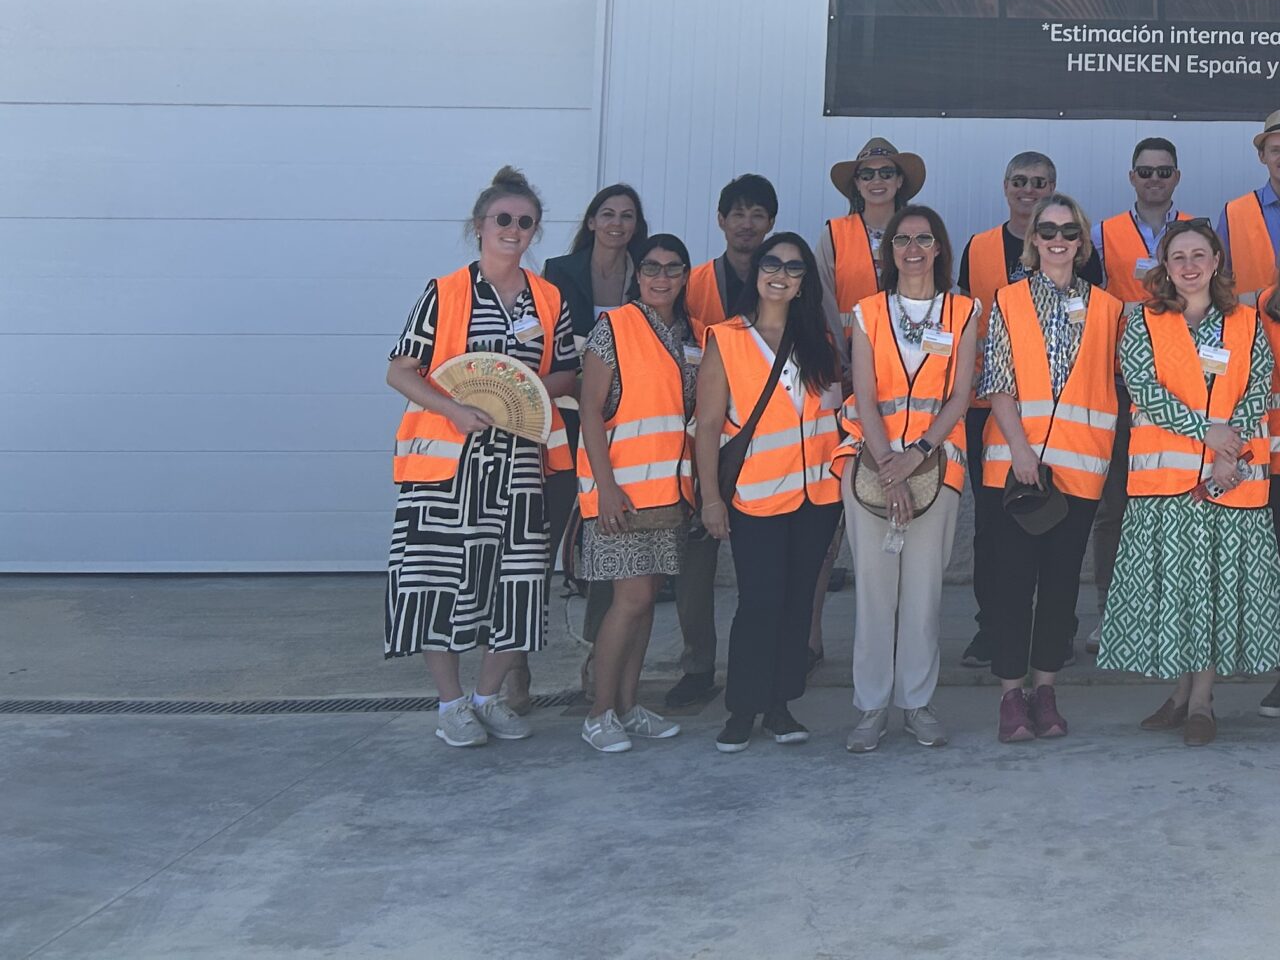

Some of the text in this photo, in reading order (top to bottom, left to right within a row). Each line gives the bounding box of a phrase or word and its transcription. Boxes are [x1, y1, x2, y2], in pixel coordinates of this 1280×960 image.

[1170, 26, 1244, 45] interna
[1067, 53, 1180, 73] HEINEKEN
[1187, 55, 1261, 78] España
[1266, 60, 1279, 79] y
